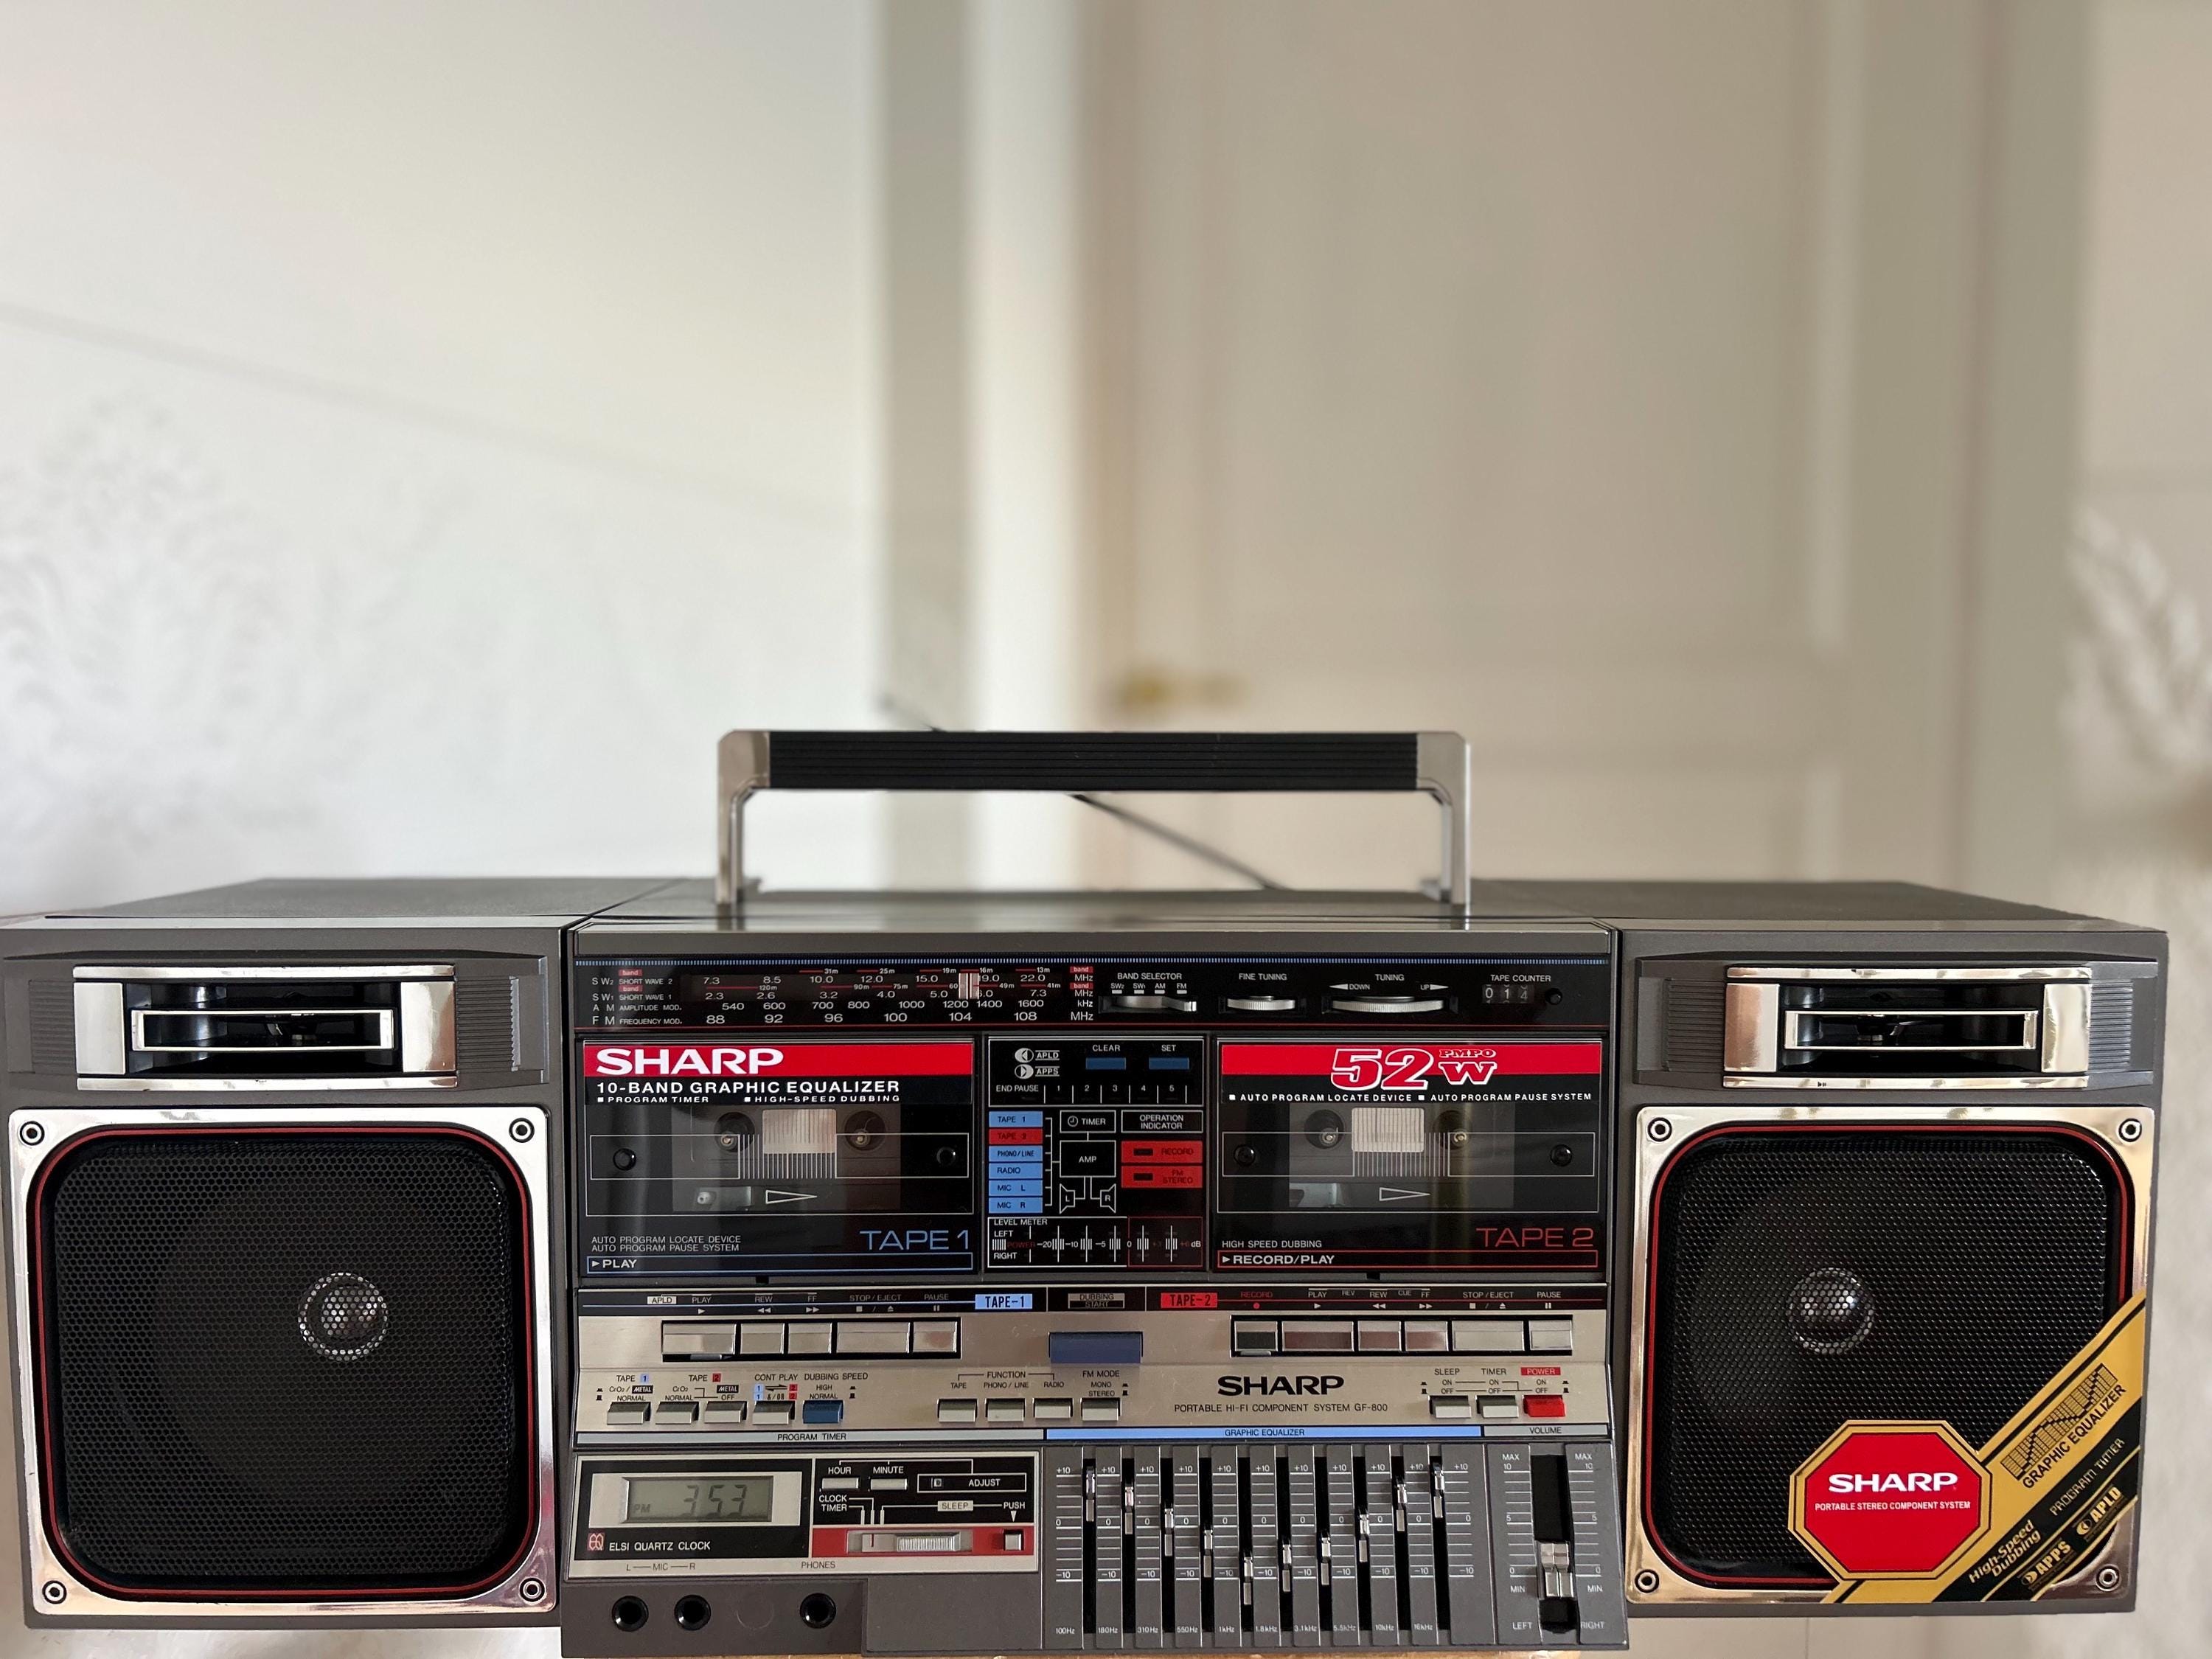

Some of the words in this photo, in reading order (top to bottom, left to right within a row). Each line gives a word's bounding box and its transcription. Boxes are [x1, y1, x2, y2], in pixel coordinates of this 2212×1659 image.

[722, 1002, 744, 1010] 540
[813, 1001, 833, 1009] 700
[899, 1001, 924, 1009] 1000
[977, 1000, 1002, 1008] 1400
[1018, 1000, 1044, 1008] 1600
[706, 1015, 725, 1024] 88
[765, 1015, 783, 1023] 92
[884, 1013, 907, 1022] 100
[1014, 1012, 1037, 1020] 108
[1071, 1012, 1093, 1020] MHz
[1439, 1049, 1496, 1057] PMPO
[597, 1048, 784, 1074] SHARP
[1331, 1048, 1434, 1091] 52
[1438, 1062, 1498, 1085] W
[597, 1082, 684, 1093] 10-BAND
[690, 1082, 780, 1093] GRAPHIC
[787, 1081, 899, 1093] EQUALIZER
[859, 1231, 949, 1250] TAPE
[957, 1230, 969, 1249] 1
[1475, 1228, 1563, 1247] TAPE
[1573, 1228, 1593, 1247] 2
[602, 1259, 637, 1268] PLAY
[1234, 1255, 1335, 1265] RECORD/PLAY
[985, 1296, 1024, 1308] TAPE-1
[1170, 1295, 1211, 1307] TAPE-2
[1218, 1376, 1344, 1396] SHARP
[1175, 1404, 1222, 1412] PORTABLE
[1354, 1403, 1388, 1411] GF-800
[2023, 1441, 2071, 1488] GRAPHIC
[2069, 1384, 2126, 1444] EQUALIZER
[828, 1467, 851, 1475] HOUR
[969, 1478, 1001, 1486] ADJUST
[2050, 1469, 2096, 1516] PROGRAM
[2095, 1438, 2126, 1474] TIMER
[1829, 1472, 1958, 1493] SHARP
[1815, 1503, 1856, 1511] PORTABLE
[1857, 1502, 1888, 1510] STEREO
[1890, 1501, 1938, 1509] COMPONENT
[1940, 1500, 1970, 1509] SYSTEM
[2090, 1486, 2121, 1527] APLD
[609, 1543, 629, 1551] ELSI
[634, 1542, 673, 1551] QUARTZ
[678, 1542, 710, 1550] CLOCK
[1969, 1520, 2034, 1584] High-Speed
[1992, 1530, 2042, 1577] Dubbing
[2034, 1541, 2071, 1576] APPS
